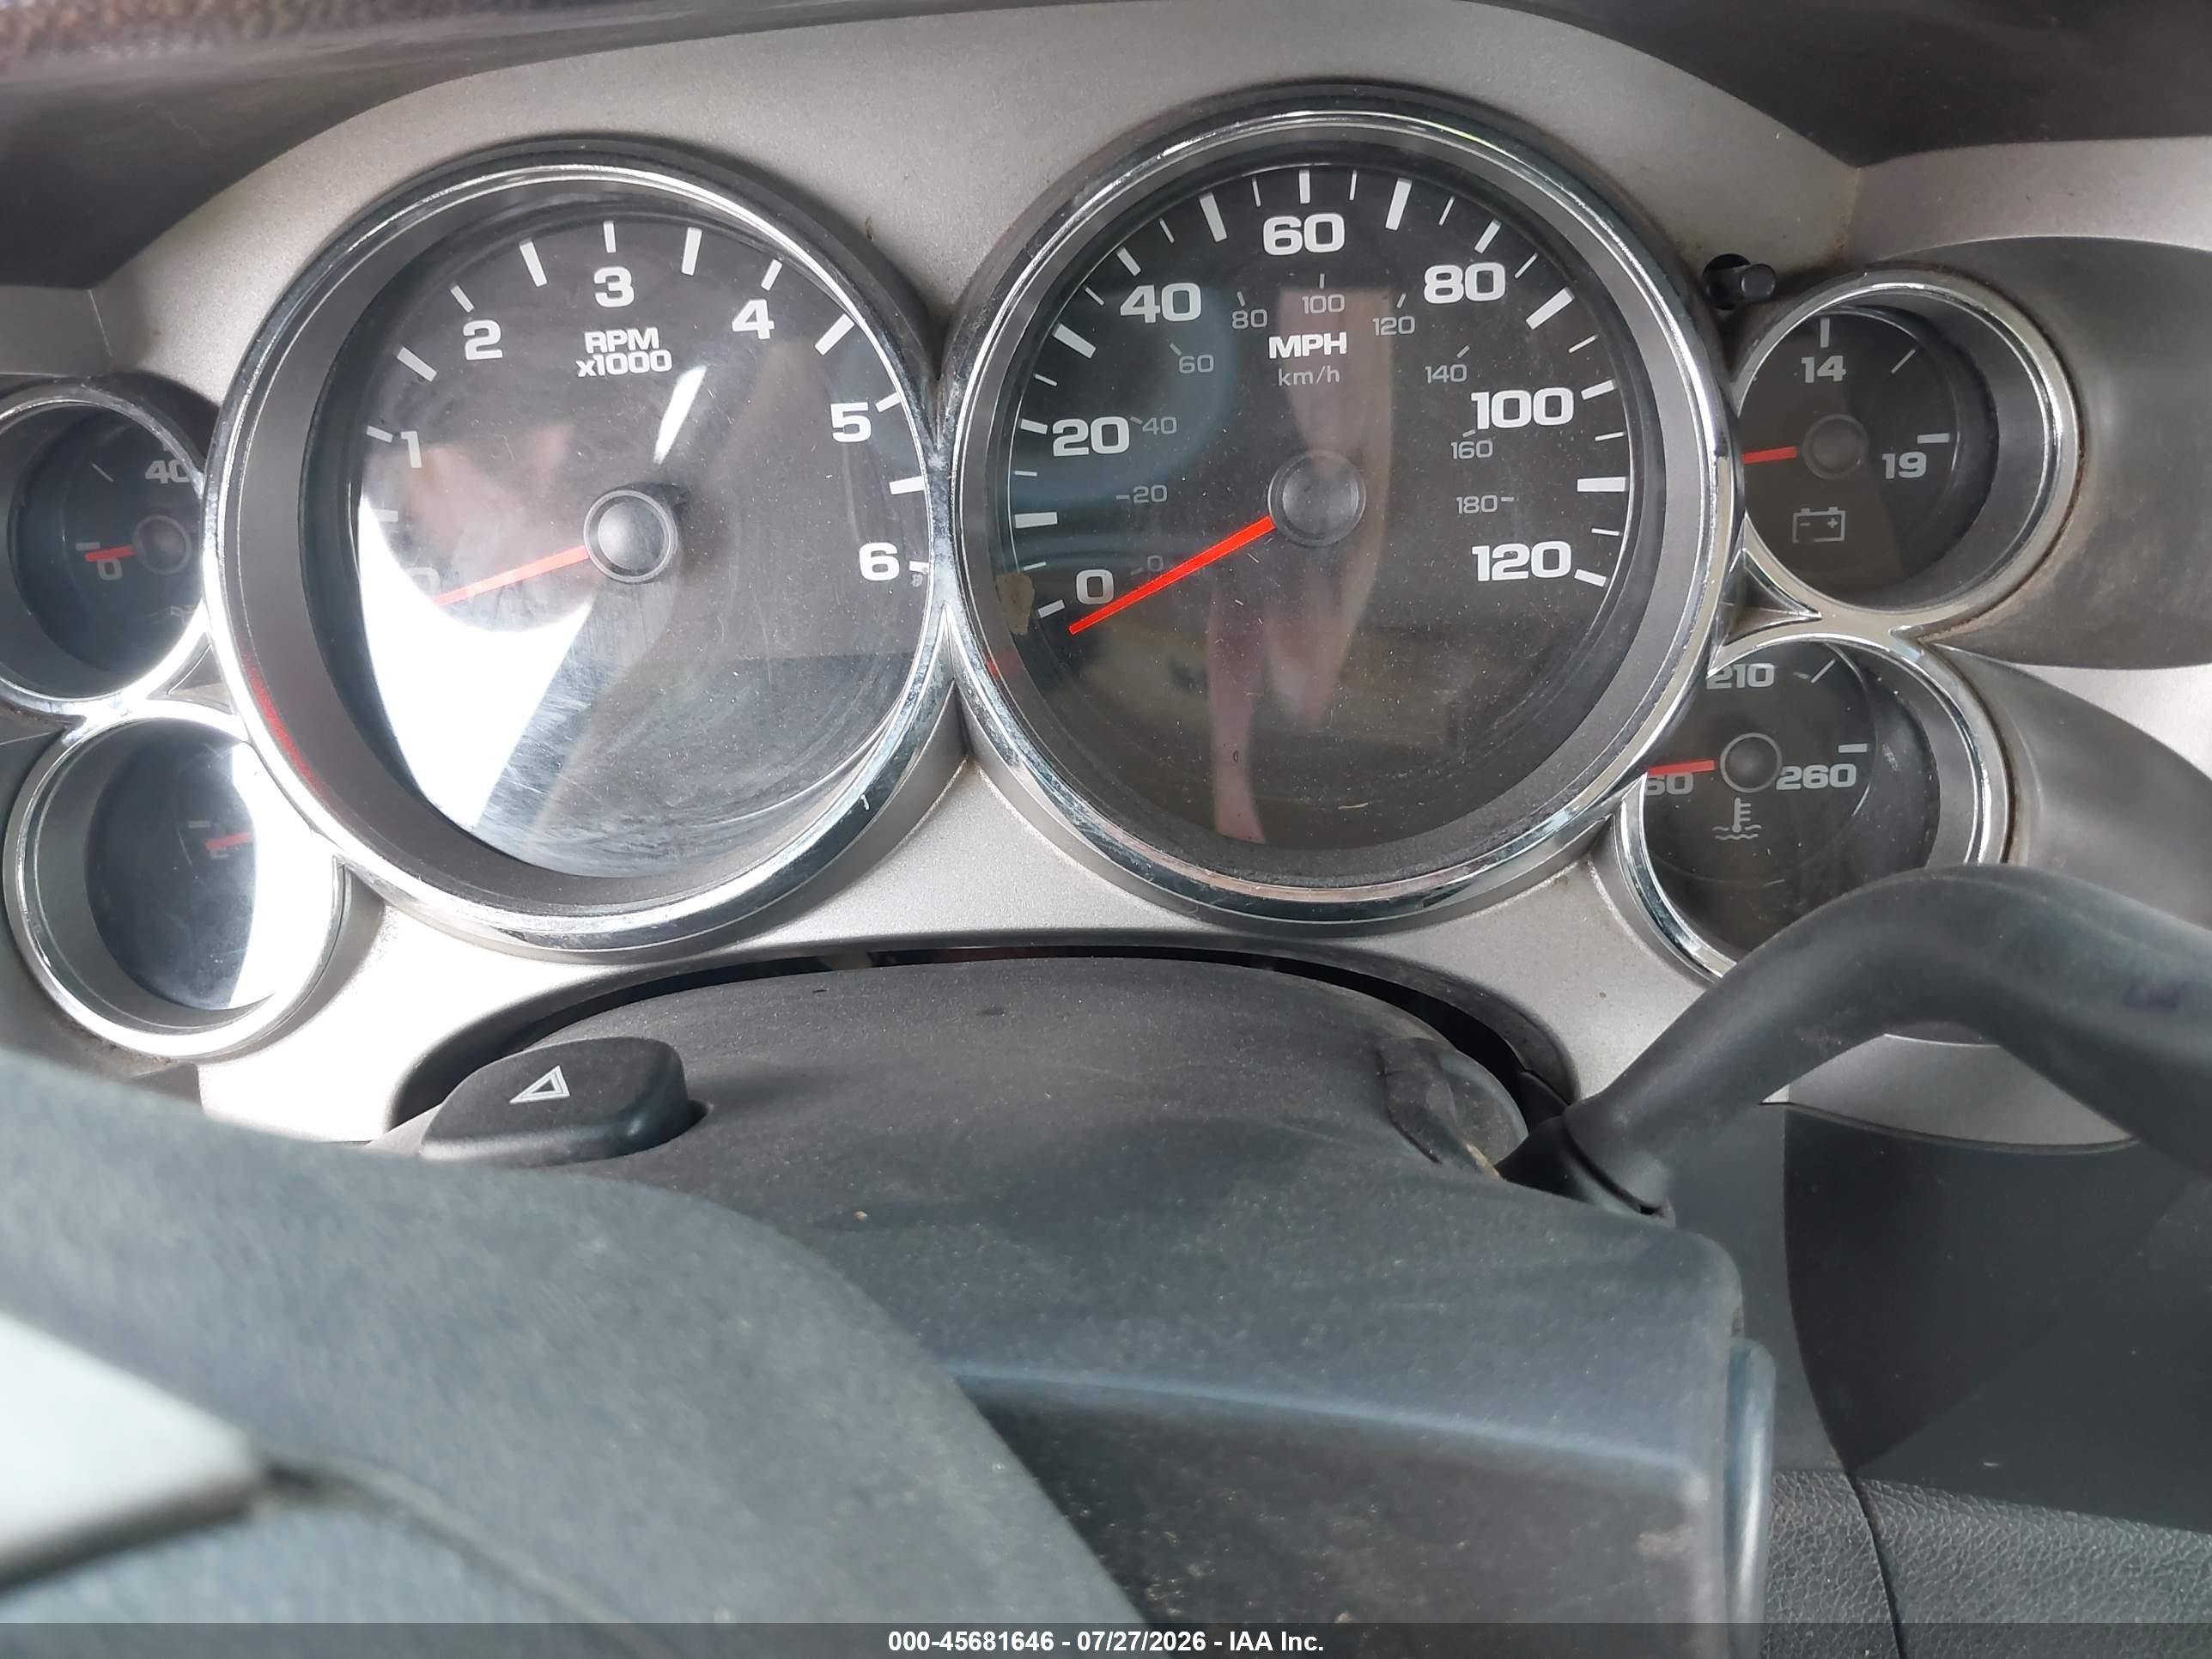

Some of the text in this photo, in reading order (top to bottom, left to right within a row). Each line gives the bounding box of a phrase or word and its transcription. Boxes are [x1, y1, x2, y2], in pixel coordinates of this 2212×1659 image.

[1263, 212, 1346, 255] 60
[593, 265, 635, 307] 3
[1423, 262, 1505, 304] 80
[1120, 283, 1201, 324] 40
[1302, 294, 1346, 314] 100
[732, 299, 775, 339] 4
[1231, 309, 1267, 329] 80
[1372, 316, 1415, 336] 120
[463, 319, 502, 360] 2
[584, 326, 659, 353] RPM
[1268, 331, 1347, 359] MPH
[576, 349, 672, 377] x1000
[1179, 355, 1214, 374] 60
[1278, 366, 1340, 387] km/h
[1425, 364, 1468, 384] 140
[1802, 356, 1846, 383] 14
[1471, 387, 1574, 429] 100
[830, 402, 872, 443] 5
[1052, 416, 1129, 456] 20
[1142, 416, 1177, 434] 40
[400, 431, 422, 468] 1
[1451, 440, 1493, 459] 160
[1882, 452, 1927, 479] 19
[1133, 484, 1168, 503] 20
[1456, 495, 1498, 514] 180
[859, 541, 900, 581] 6
[1472, 541, 1571, 581] 120
[1076, 568, 1114, 605] 0
[1776, 763, 1856, 791] 260
